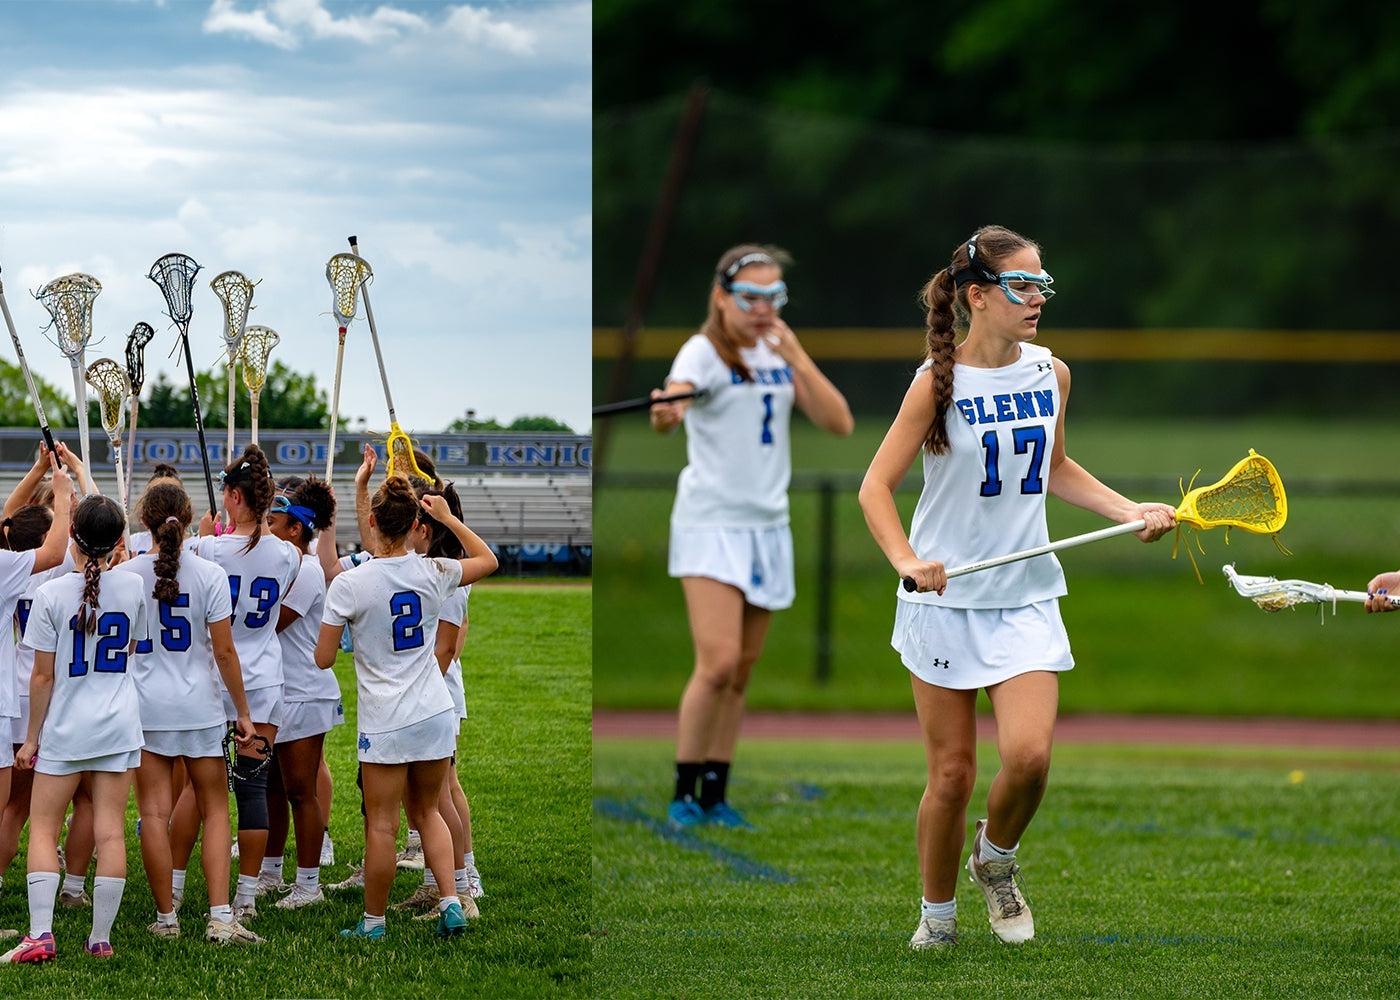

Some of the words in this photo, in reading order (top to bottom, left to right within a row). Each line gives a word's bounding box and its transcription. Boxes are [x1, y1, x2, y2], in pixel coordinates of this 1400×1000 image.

[761, 393, 773, 445] 1
[956, 389, 1054, 425] GLENN
[275, 440, 344, 465] OF
[979, 424, 1047, 498] 17
[68, 611, 131, 678] 12
[389, 590, 425, 652] 2
